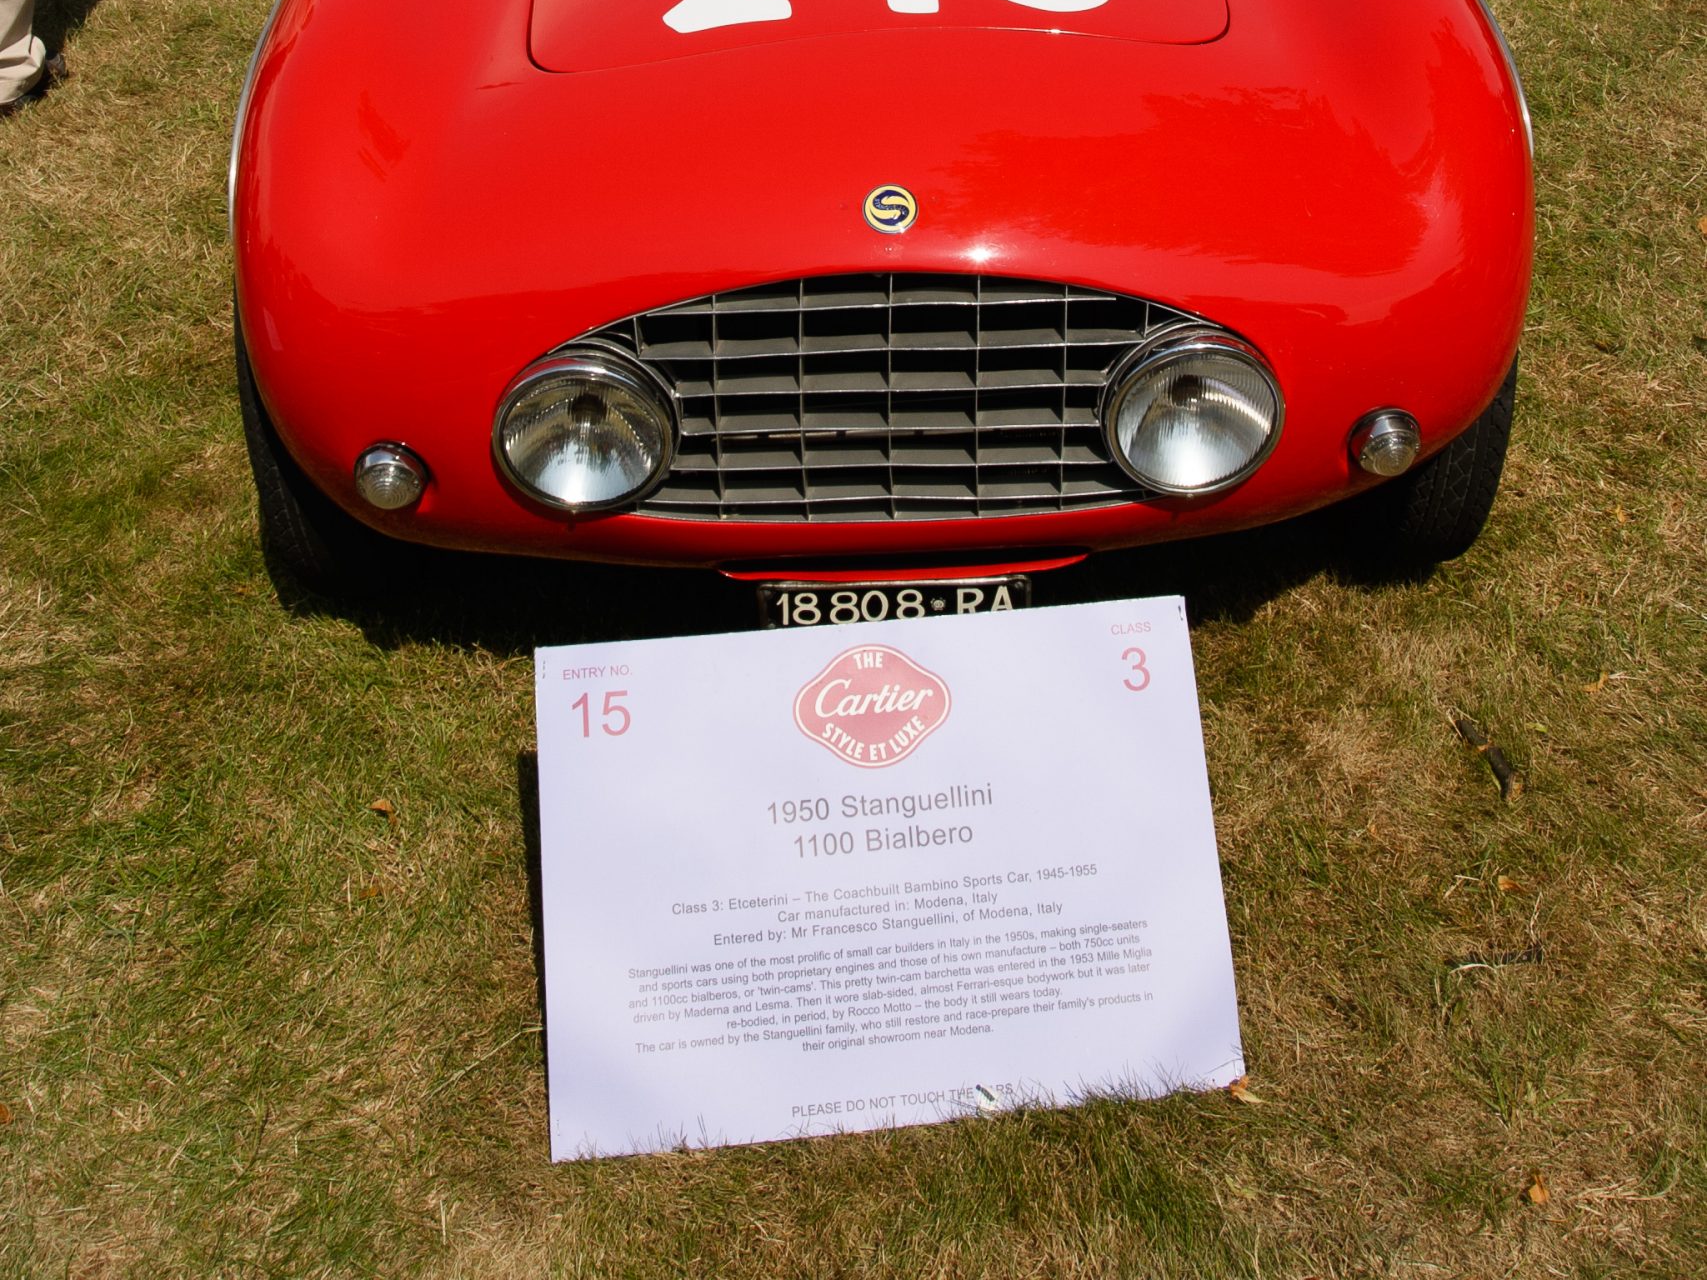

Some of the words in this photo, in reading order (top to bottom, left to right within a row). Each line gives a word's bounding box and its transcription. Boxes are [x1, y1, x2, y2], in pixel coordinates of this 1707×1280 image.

[776, 589, 926, 626] 18808
[957, 585, 1014, 615] RA
[1110, 621, 1151, 635] CLASS
[562, 665, 605, 681] ENTRY
[609, 664, 633, 677] NO.
[853, 651, 883, 669] THE
[1121, 647, 1150, 692] 3
[571, 690, 631, 738] 15
[815, 678, 934, 718] Cartier
[822, 722, 865, 760] STYLE
[869, 742, 888, 761] ET
[888, 715, 926, 754] LUXE
[767, 797, 830, 825] 1950
[841, 783, 993, 819] Stanguellini
[794, 831, 854, 858] 1100
[866, 825, 973, 852] Bialbero
[672, 902, 707, 915] Class
[712, 899, 723, 912] 3:
[729, 894, 788, 910] Etceterini
[804, 890, 829, 902] The
[834, 884, 900, 900] Coachbuilt
[904, 879, 958, 893] Bambino
[963, 874, 1003, 889] Sports
[1007, 871, 1032, 883] Car,
[1036, 863, 1097, 880] 1945-1955
[778, 910, 800, 923] Car
[805, 902, 890, 919] manufactured
[895, 900, 909, 911] in:
[914, 896, 967, 909] Modena,
[972, 891, 998, 905] Italy
[714, 930, 763, 945] Entered
[768, 929, 786, 943] by:
[792, 926, 807, 939] Mr
[812, 921, 877, 936] Francesco
[882, 912, 958, 930] Stanguellini,
[963, 909, 974, 921] of
[979, 906, 1032, 920] Modena,
[1037, 901, 1062, 915] Italy
[628, 964, 688, 979] Stanguellini
[691, 963, 711, 973] was
[715, 961, 734, 970] one
[737, 957, 747, 969] of
[750, 957, 766, 967] the
[770, 954, 794, 965] most
[798, 950, 831, 965] prolific
[834, 948, 843, 959] of
[847, 945, 873, 958] small
[876, 945, 892, 955] car
[895, 941, 934, 953] builders
[937, 940, 946, 949] in
[950, 937, 970, 948] Italy
[973, 936, 982, 945] in
[985, 934, 1001, 944] the
[1005, 930, 1037, 942] 1950s,
[1041, 926, 1076, 938] making
[1079, 920, 1148, 935] single-seaters
[639, 981, 658, 993] and
[662, 979, 693, 991] sports
[696, 977, 718, 987] cars
[721, 974, 749, 986] using
[752, 970, 774, 982] both
[777, 967, 832, 981] proprietary
[835, 962, 875, 975] engines
[878, 958, 896, 970] and
[900, 957, 927, 967] those
[929, 953, 940, 964] of
[943, 953, 958, 963] his
[961, 952, 981, 961] own
[985, 944, 1046, 958] manufacture
[1059, 940, 1081, 951] both
[1084, 937, 1114, 948] 750cc
[1117, 934, 1141, 945] units
[628, 997, 648, 1008] and
[652, 994, 688, 1006] 1100cc
[691, 990, 741, 1003] bialberos,
[744, 988, 755, 997] or
[819, 979, 841, 989] This
[845, 976, 873, 990] pretty
[876, 972, 921, 984] twin-cam
[924, 966, 971, 979] barchetta
[974, 965, 994, 974] was
[998, 959, 1035, 972] entered
[1038, 958, 1047, 967] in
[1050, 956, 1066, 967] the
[1070, 952, 1094, 964] 1953
[1097, 950, 1120, 961] Mille
[1123, 947, 1152, 959] Miglia
[633, 1012, 665, 1023] driven
[668, 1010, 681, 1021] by
[732, 1002, 752, 1014] and
[796, 996, 822, 1007] Then
[825, 994, 832, 1004] it
[834, 993, 859, 1003] wore
[862, 986, 917, 1000] slab-sided,
[921, 982, 954, 995] almost
[957, 977, 1024, 990] Ferrari-esque
[1027, 970, 1075, 984] bodywork
[1077, 967, 1094, 978] but
[1096, 967, 1103, 976] it
[1105, 966, 1125, 975] was
[1128, 963, 1151, 973] later
[635, 1042, 655, 1053] The
[659, 1041, 676, 1051] car
[678, 1039, 687, 1049] is
[690, 1034, 724, 1048] owned
[728, 1034, 740, 1046] by
[743, 1032, 760, 1042] the
[763, 1025, 822, 1040] Stanguellini
[826, 1022, 857, 1034] family,
[860, 1020, 882, 1031] who
[885, 1017, 901, 1028] still
[905, 1015, 940, 1026] restore
[944, 1011, 962, 1022] and
[966, 1006, 1030, 1019] race-prepare
[1033, 1001, 1055, 1013] their
[1057, 998, 1095, 1010] family's
[1098, 993, 1142, 1008] products
[1144, 991, 1153, 1000] in
[727, 1015, 778, 1029] re-bodied,
[782, 1014, 791, 1024] in
[794, 1010, 829, 1025] period,
[832, 1009, 844, 1020] by
[848, 1006, 880, 1017] Rocco
[884, 1002, 912, 1013] Motto
[925, 999, 940, 1009] the
[944, 996, 968, 1008] body
[971, 994, 977, 1004] it
[980, 992, 996, 1003] still
[1000, 991, 1030, 1001] wears
[802, 1040, 825, 1052] their
[828, 1035, 865, 1050] original
[868, 1032, 921, 1045] showroom
[924, 1029, 947, 1039] near
[950, 1024, 994, 1036] Modena.
[792, 1100, 842, 1117] PLEASE
[846, 1099, 865, 1112] DO
[869, 1095, 897, 1110] NOT
[900, 1090, 944, 1106] TOUCH
[949, 1087, 973, 1100] THE
